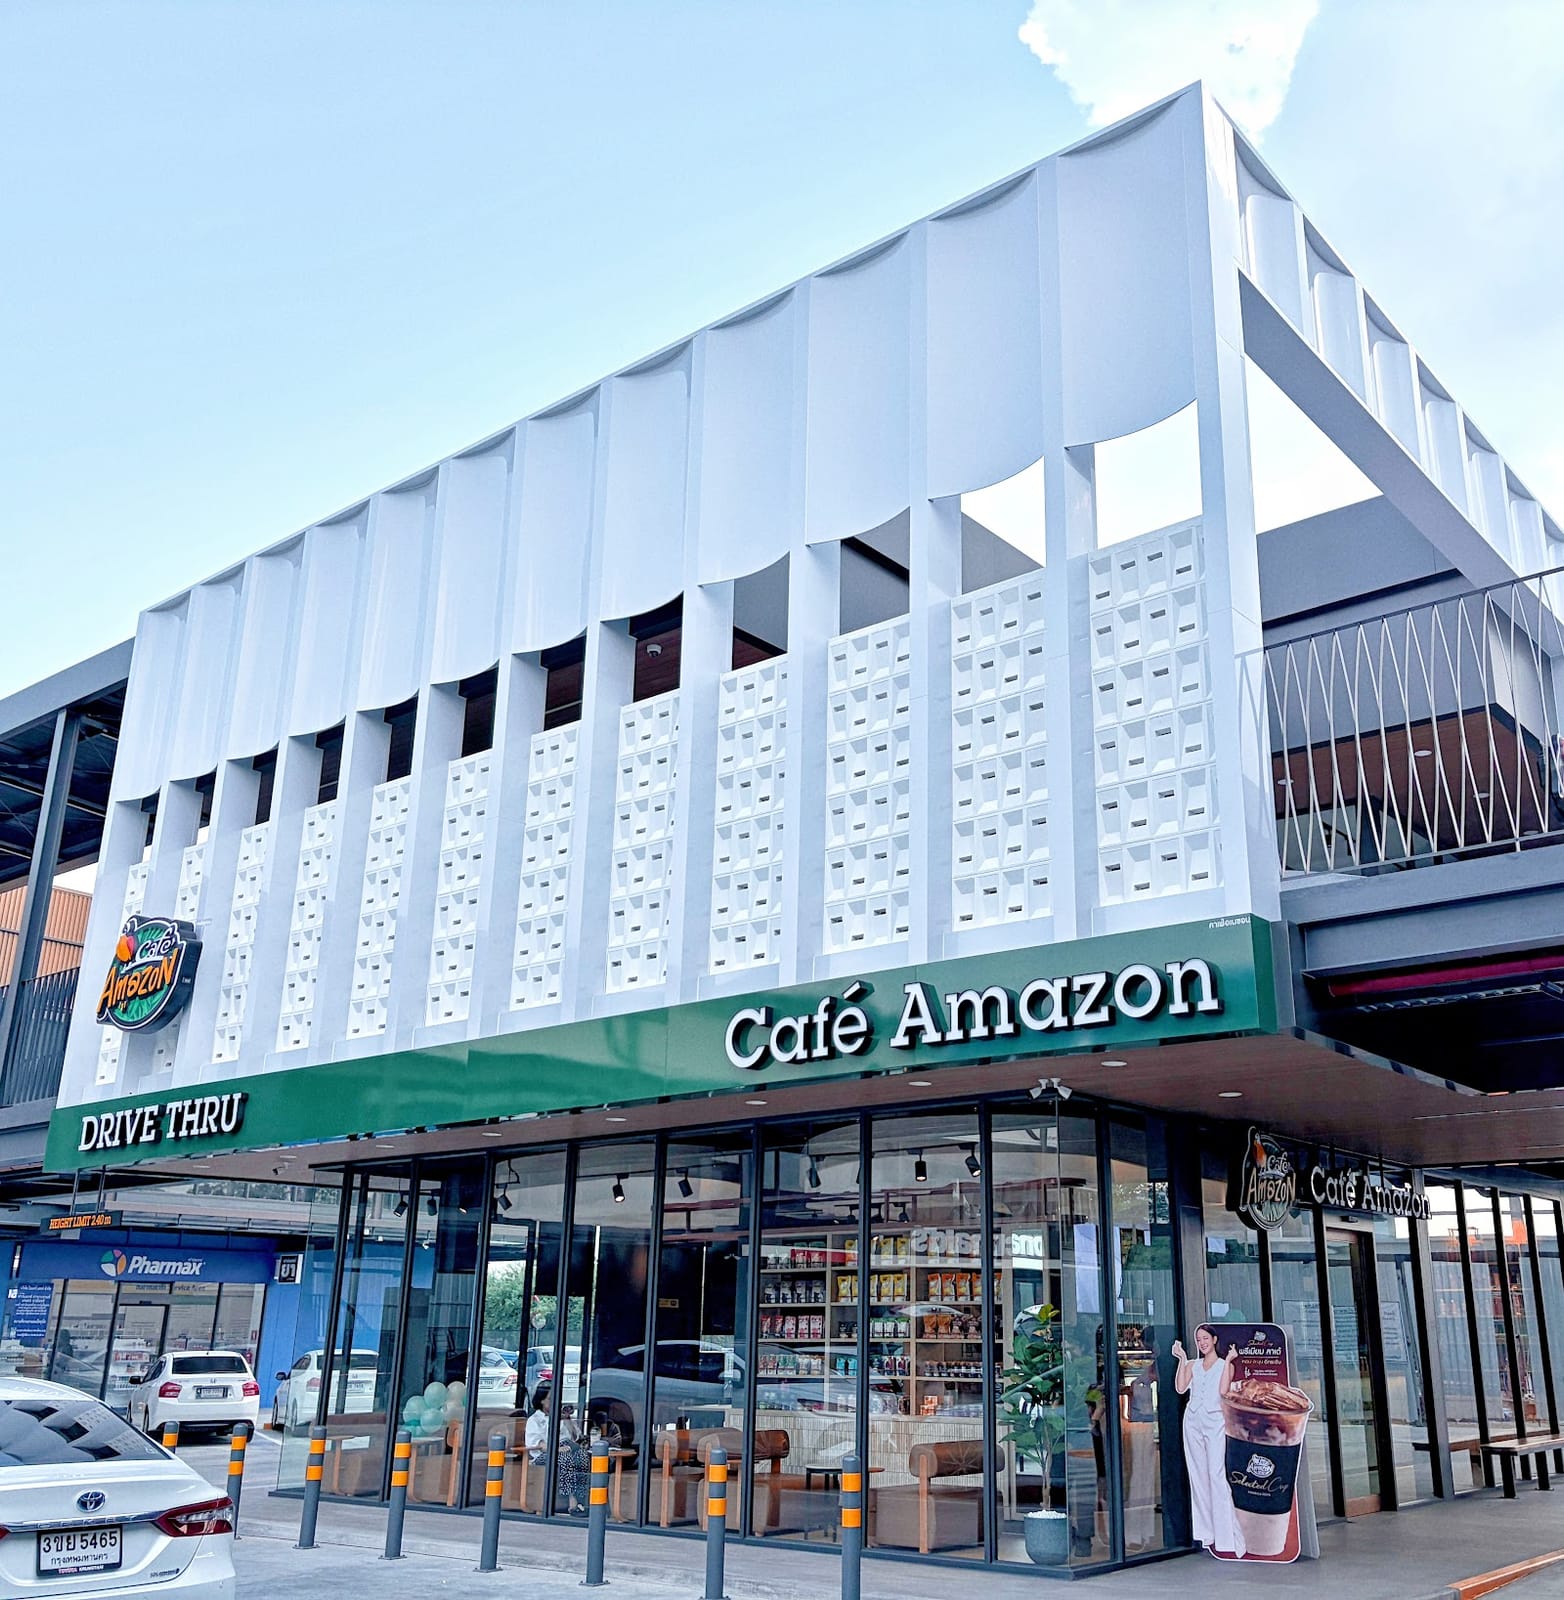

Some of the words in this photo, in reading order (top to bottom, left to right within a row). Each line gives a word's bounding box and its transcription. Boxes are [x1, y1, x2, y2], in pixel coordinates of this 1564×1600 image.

[725, 981, 868, 1069] Café
[889, 957, 1222, 1048] Amazon
[79, 1105, 160, 1151] DRIVE
[166, 1094, 242, 1139] THRU
[1310, 1165, 1357, 1209] Café
[1361, 1175, 1432, 1220] Amazon
[49, 1218, 73, 1230] HEIGHT
[73, 1215, 91, 1228] LIMIT
[128, 1255, 202, 1276] Pharmax
[42, 1535, 76, 1554] 3ขย
[80, 1530, 118, 1549] 5465
[50, 1554, 109, 1567] กรุงเทพมหานคร
